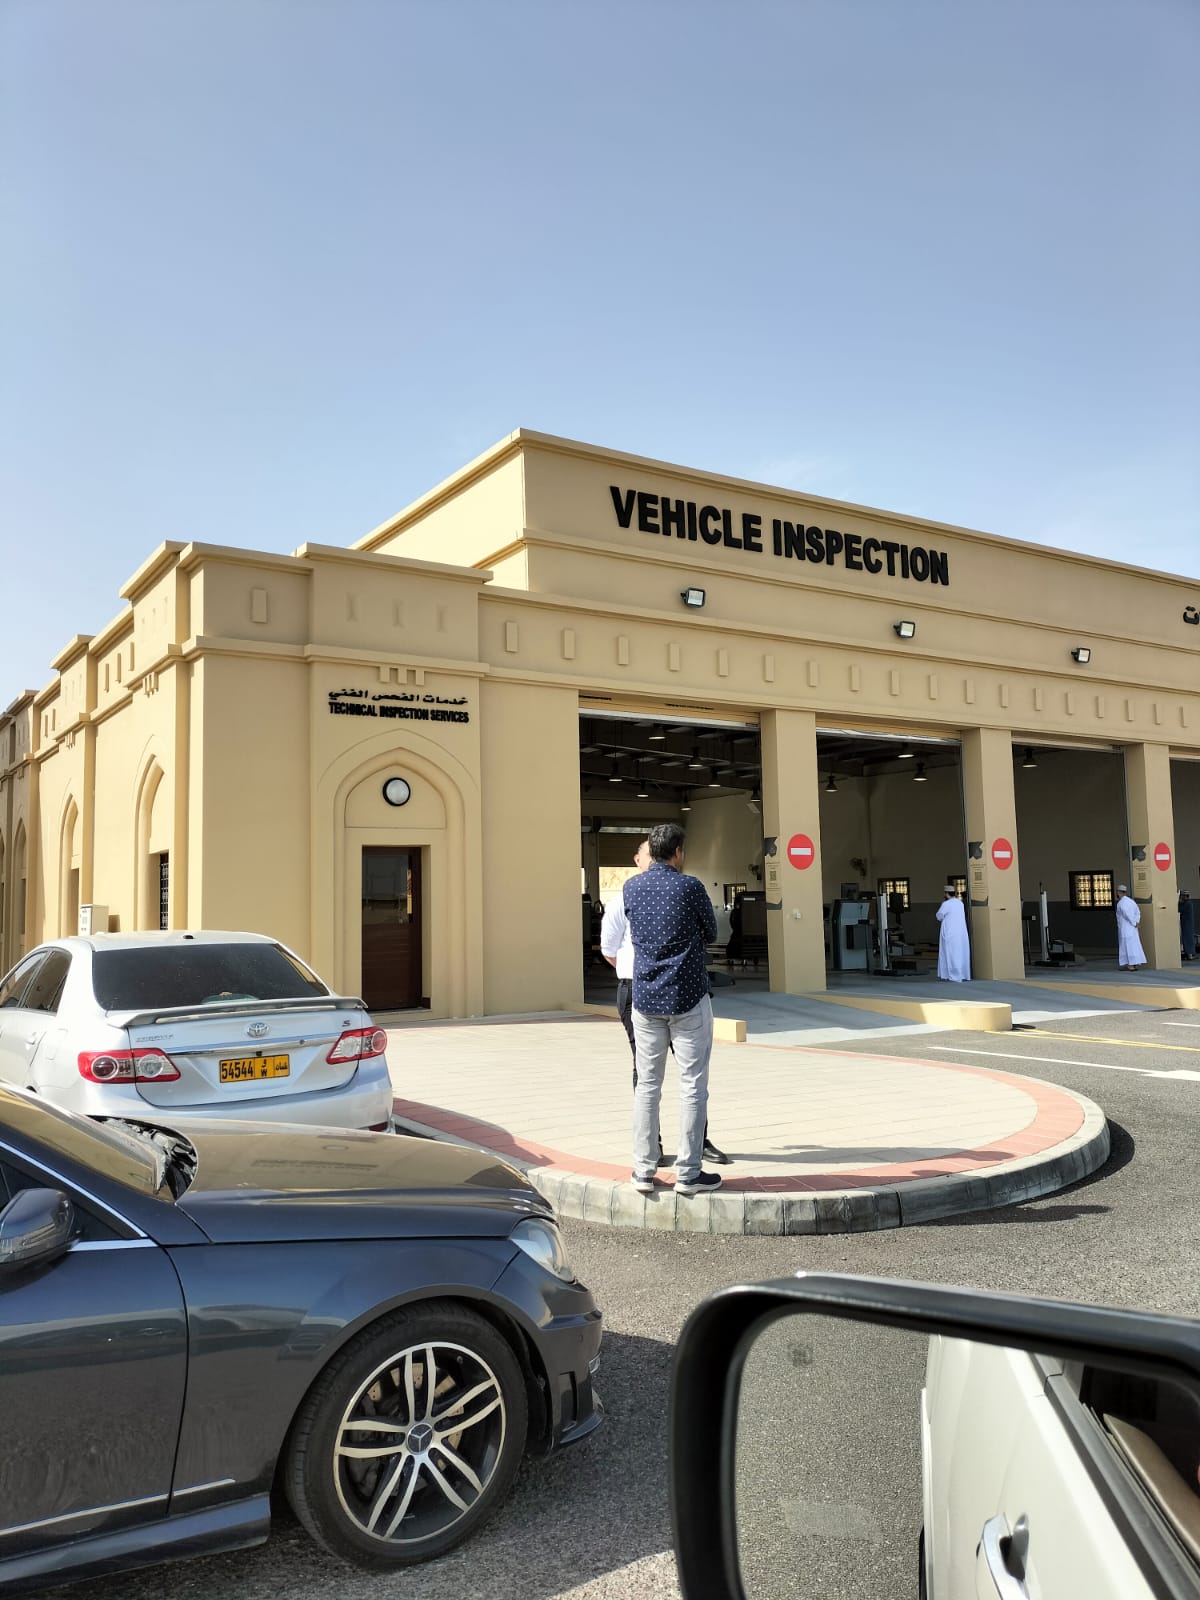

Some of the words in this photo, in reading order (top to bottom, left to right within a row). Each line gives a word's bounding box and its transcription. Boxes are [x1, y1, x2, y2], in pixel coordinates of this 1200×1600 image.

[609, 485, 763, 553] VEHICLE
[773, 519, 950, 586] INSPECTION
[328, 688, 368, 700] الفني
[371, 692, 420, 702] الفحص
[422, 694, 469, 705] خدمات
[328, 701, 378, 717] TECHNICAL
[379, 705, 429, 721] INSPECTION
[430, 709, 469, 723] SERVICES
[221, 1061, 253, 1080] 54544
[261, 1068, 267, 1076] W
